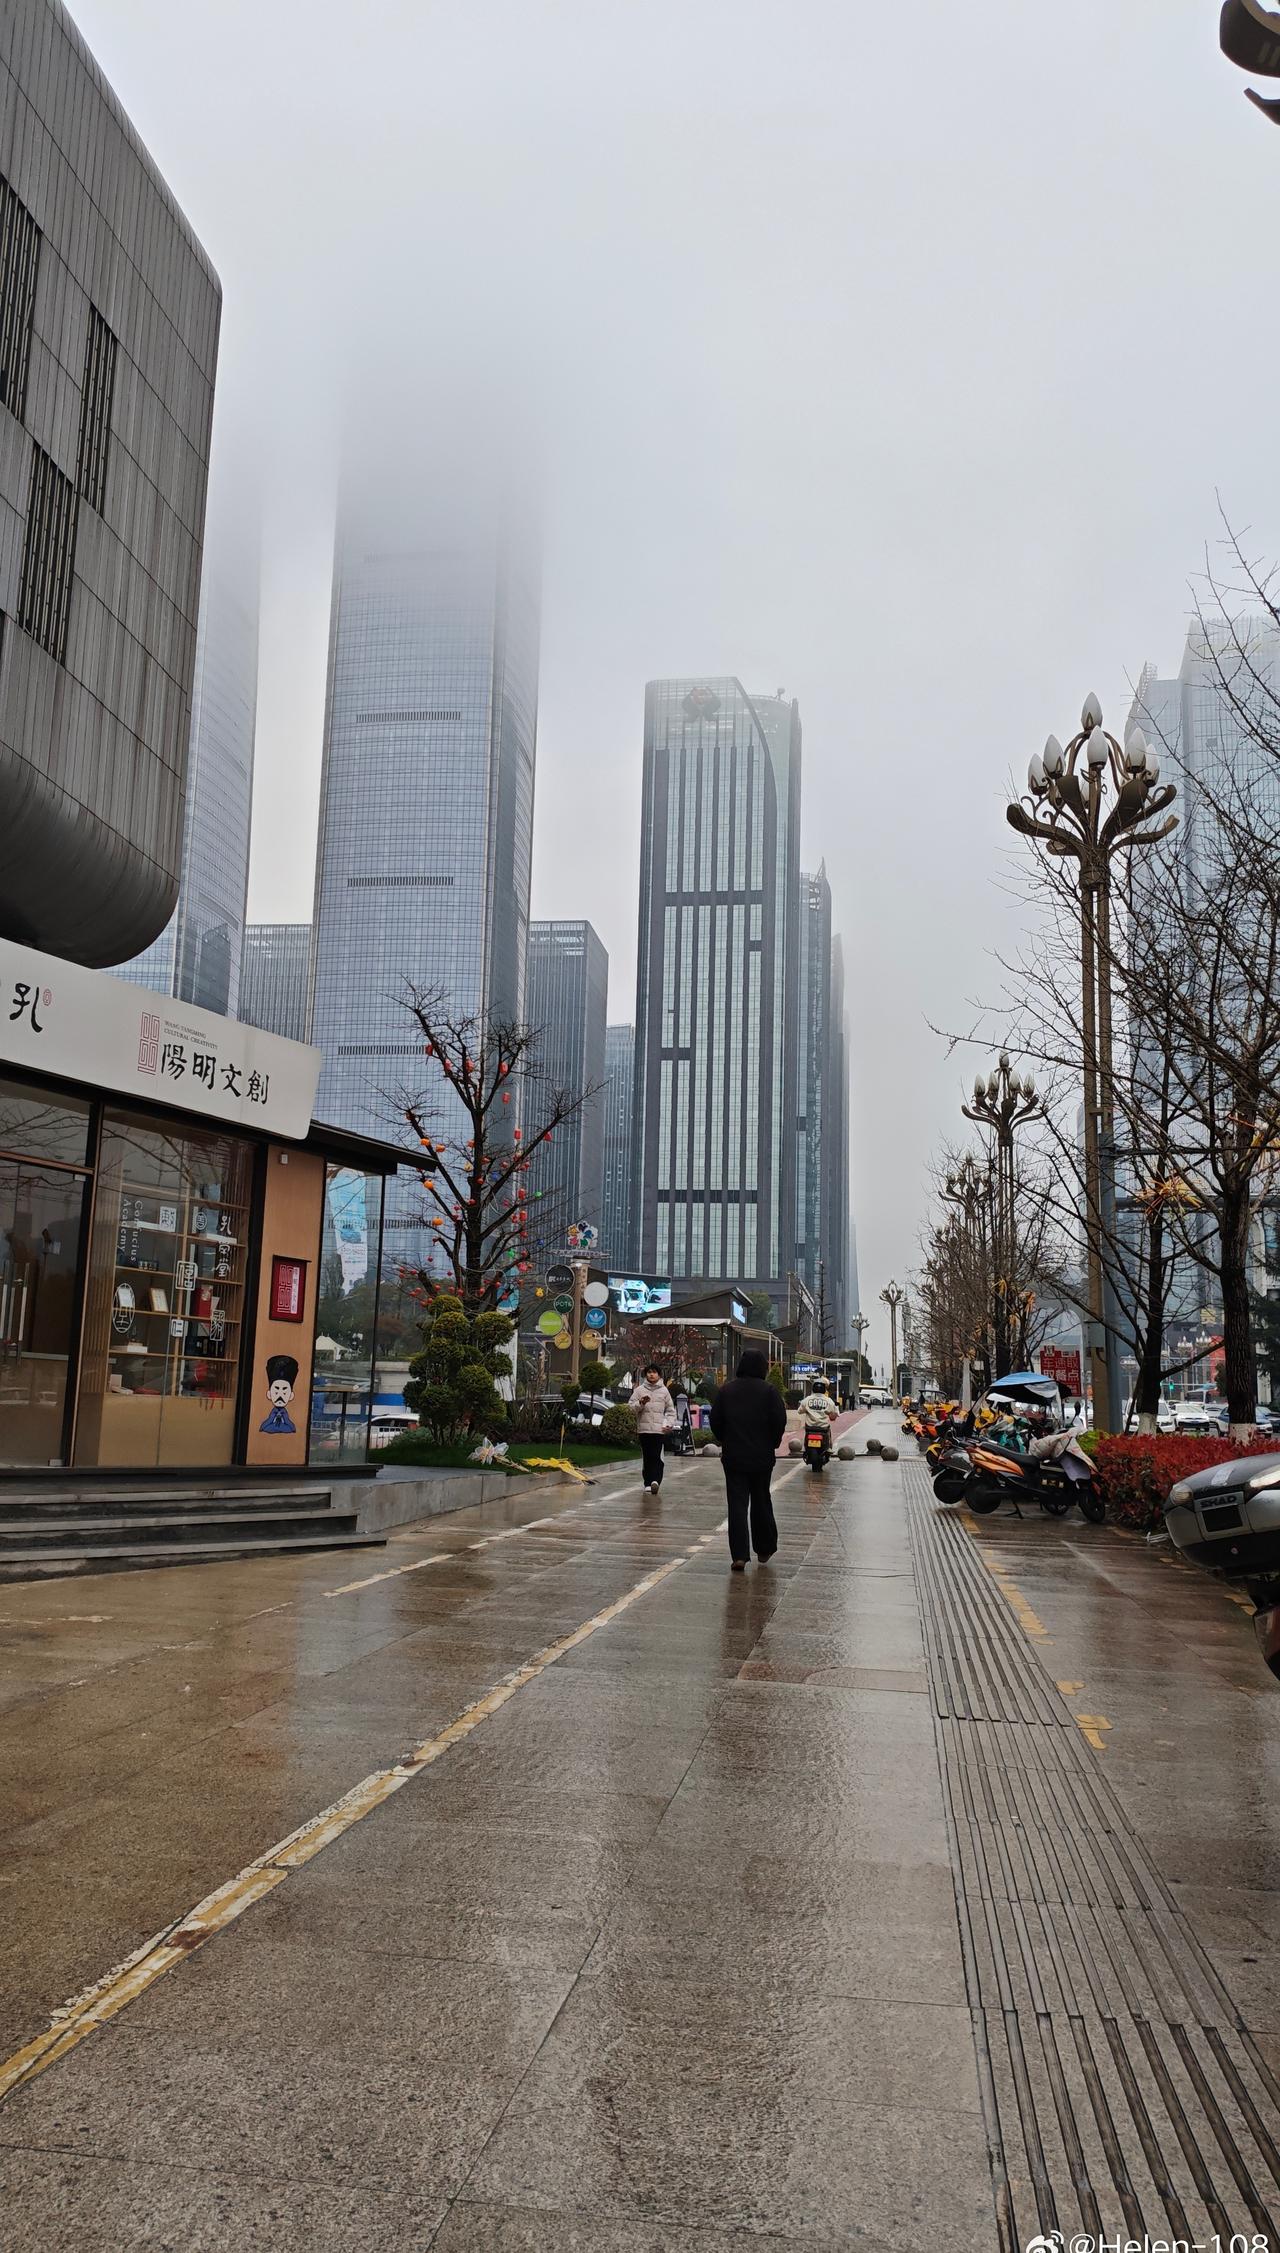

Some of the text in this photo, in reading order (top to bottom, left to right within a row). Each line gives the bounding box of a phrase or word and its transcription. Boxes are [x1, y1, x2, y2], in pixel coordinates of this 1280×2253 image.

[163, 1028, 218, 1050] CULTURAL CREATIVITY
[161, 1043, 269, 1105] 陽明文創
[118, 1199, 131, 1252] Academy
[130, 1200, 143, 1262] Confucius
